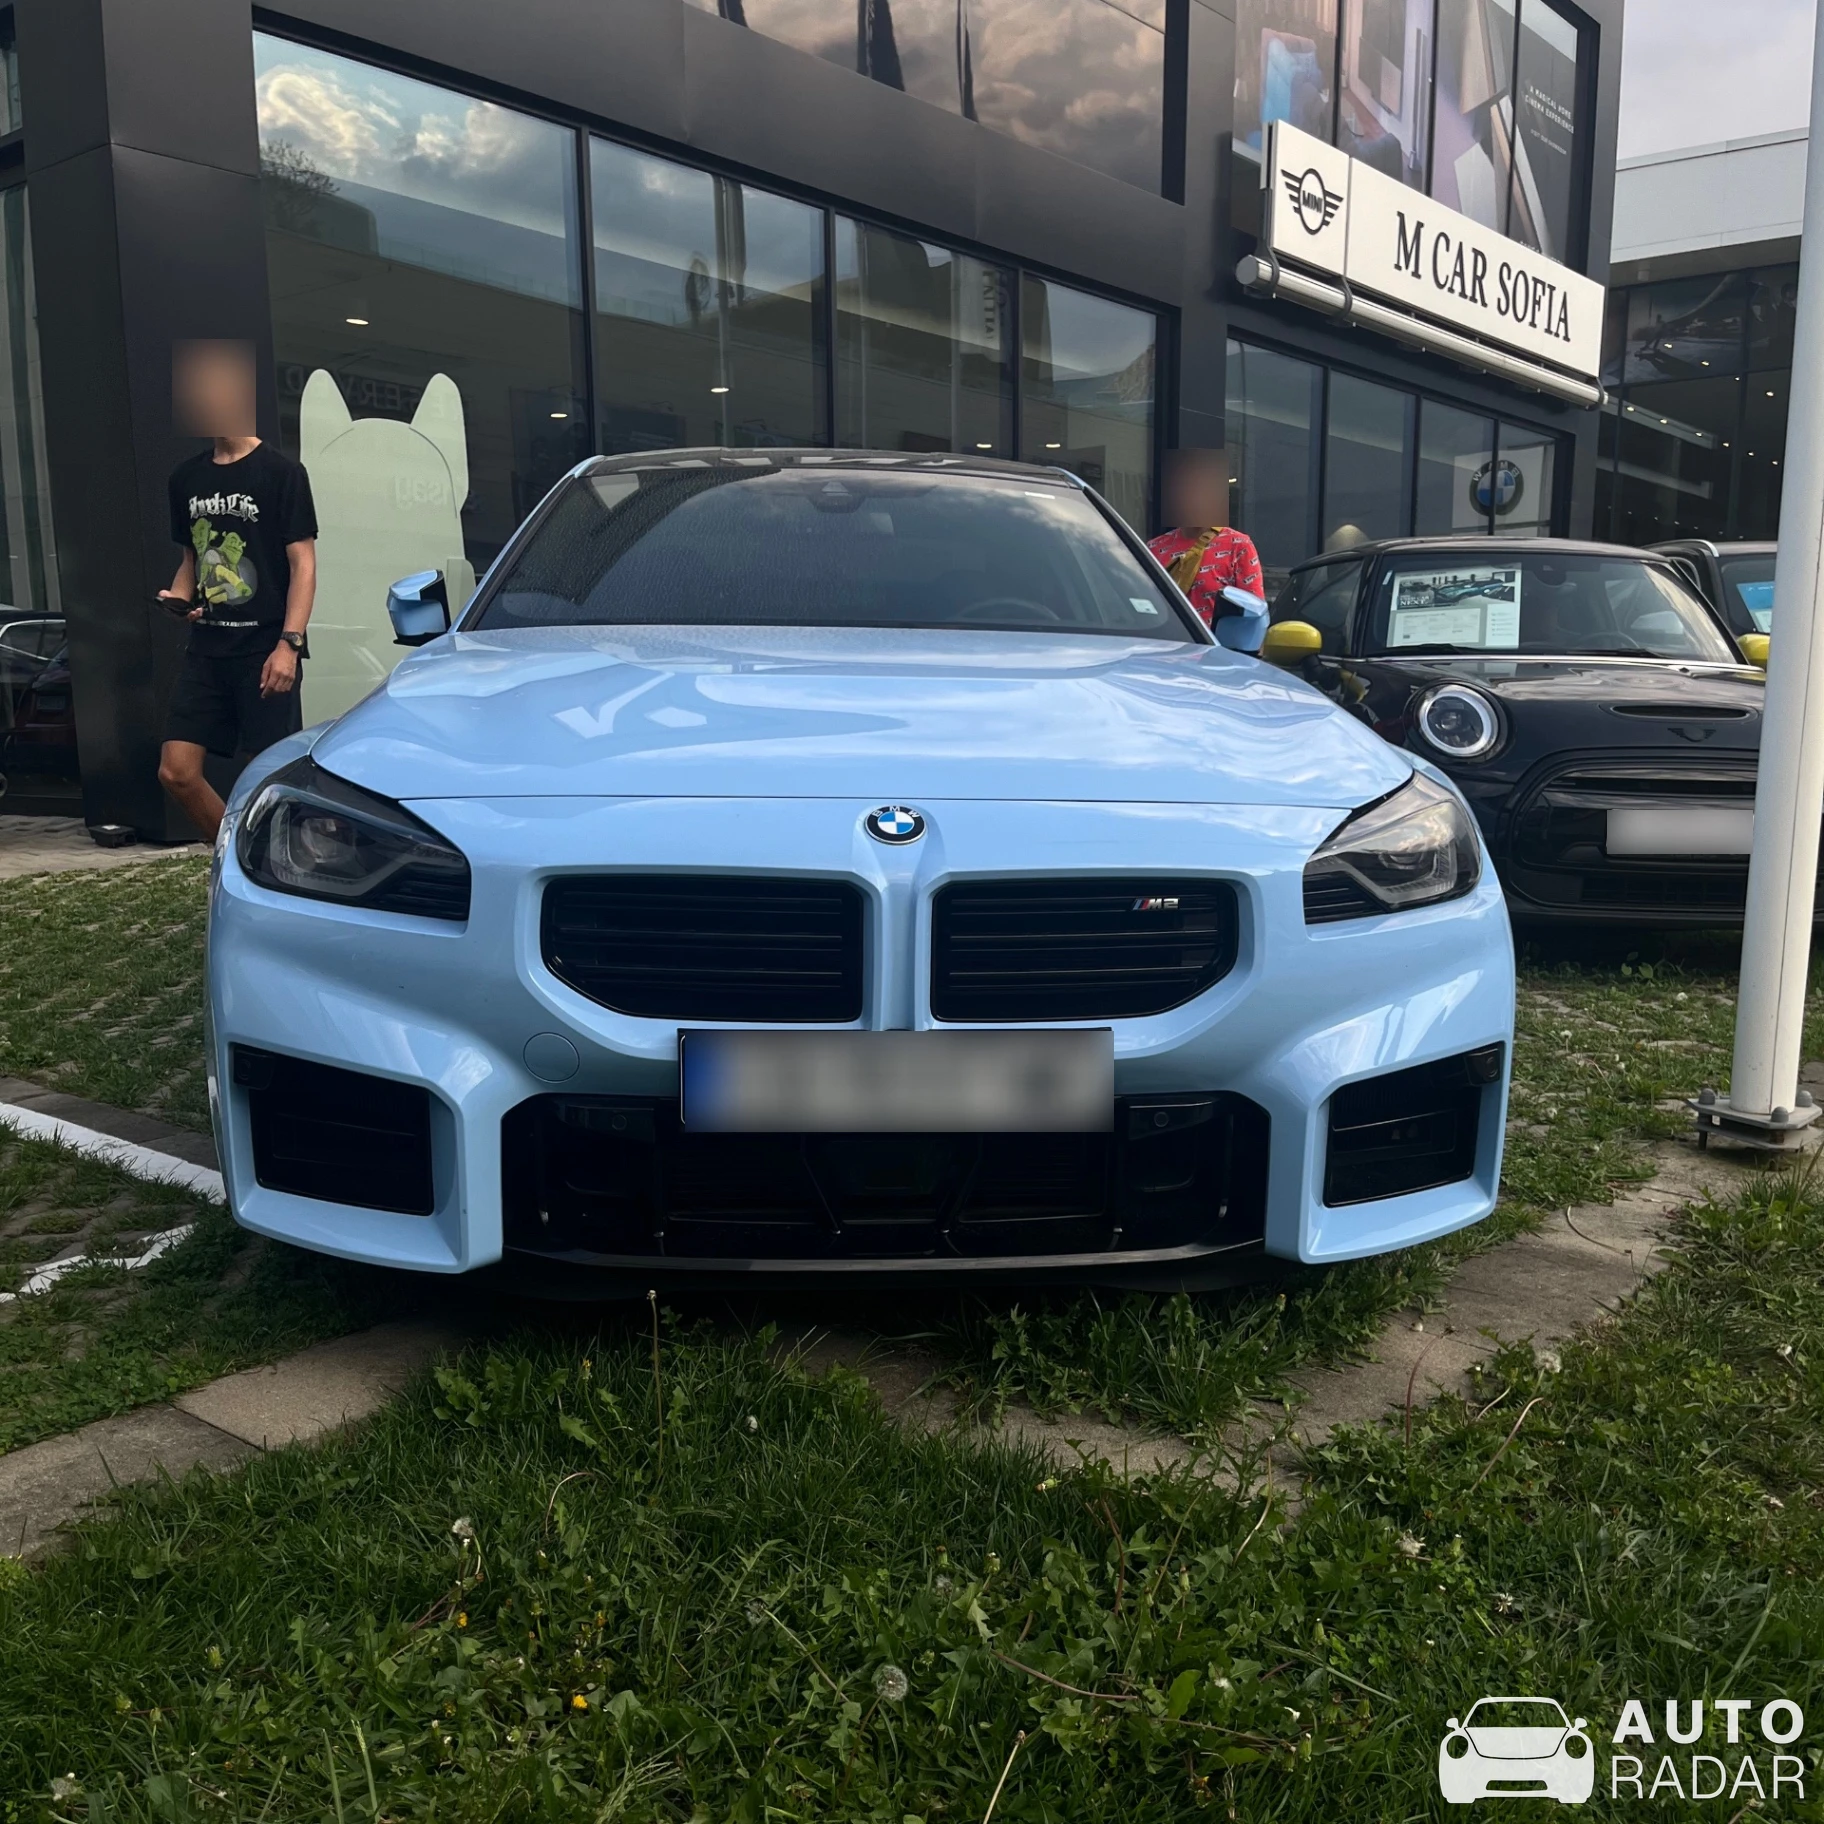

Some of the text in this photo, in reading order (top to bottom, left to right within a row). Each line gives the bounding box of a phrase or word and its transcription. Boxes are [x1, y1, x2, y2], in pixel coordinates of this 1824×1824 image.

[1525, 94, 1574, 134] CINEMA EXPERIENCE
[1535, 88, 1556, 110] MAGICAL
[1558, 104, 1571, 120] HOME
[1302, 190, 1323, 214] MINI
[1394, 210, 1571, 343] M CAR SOFIA
[227, 493, 260, 523] Life
[871, 805, 921, 818] BMW
